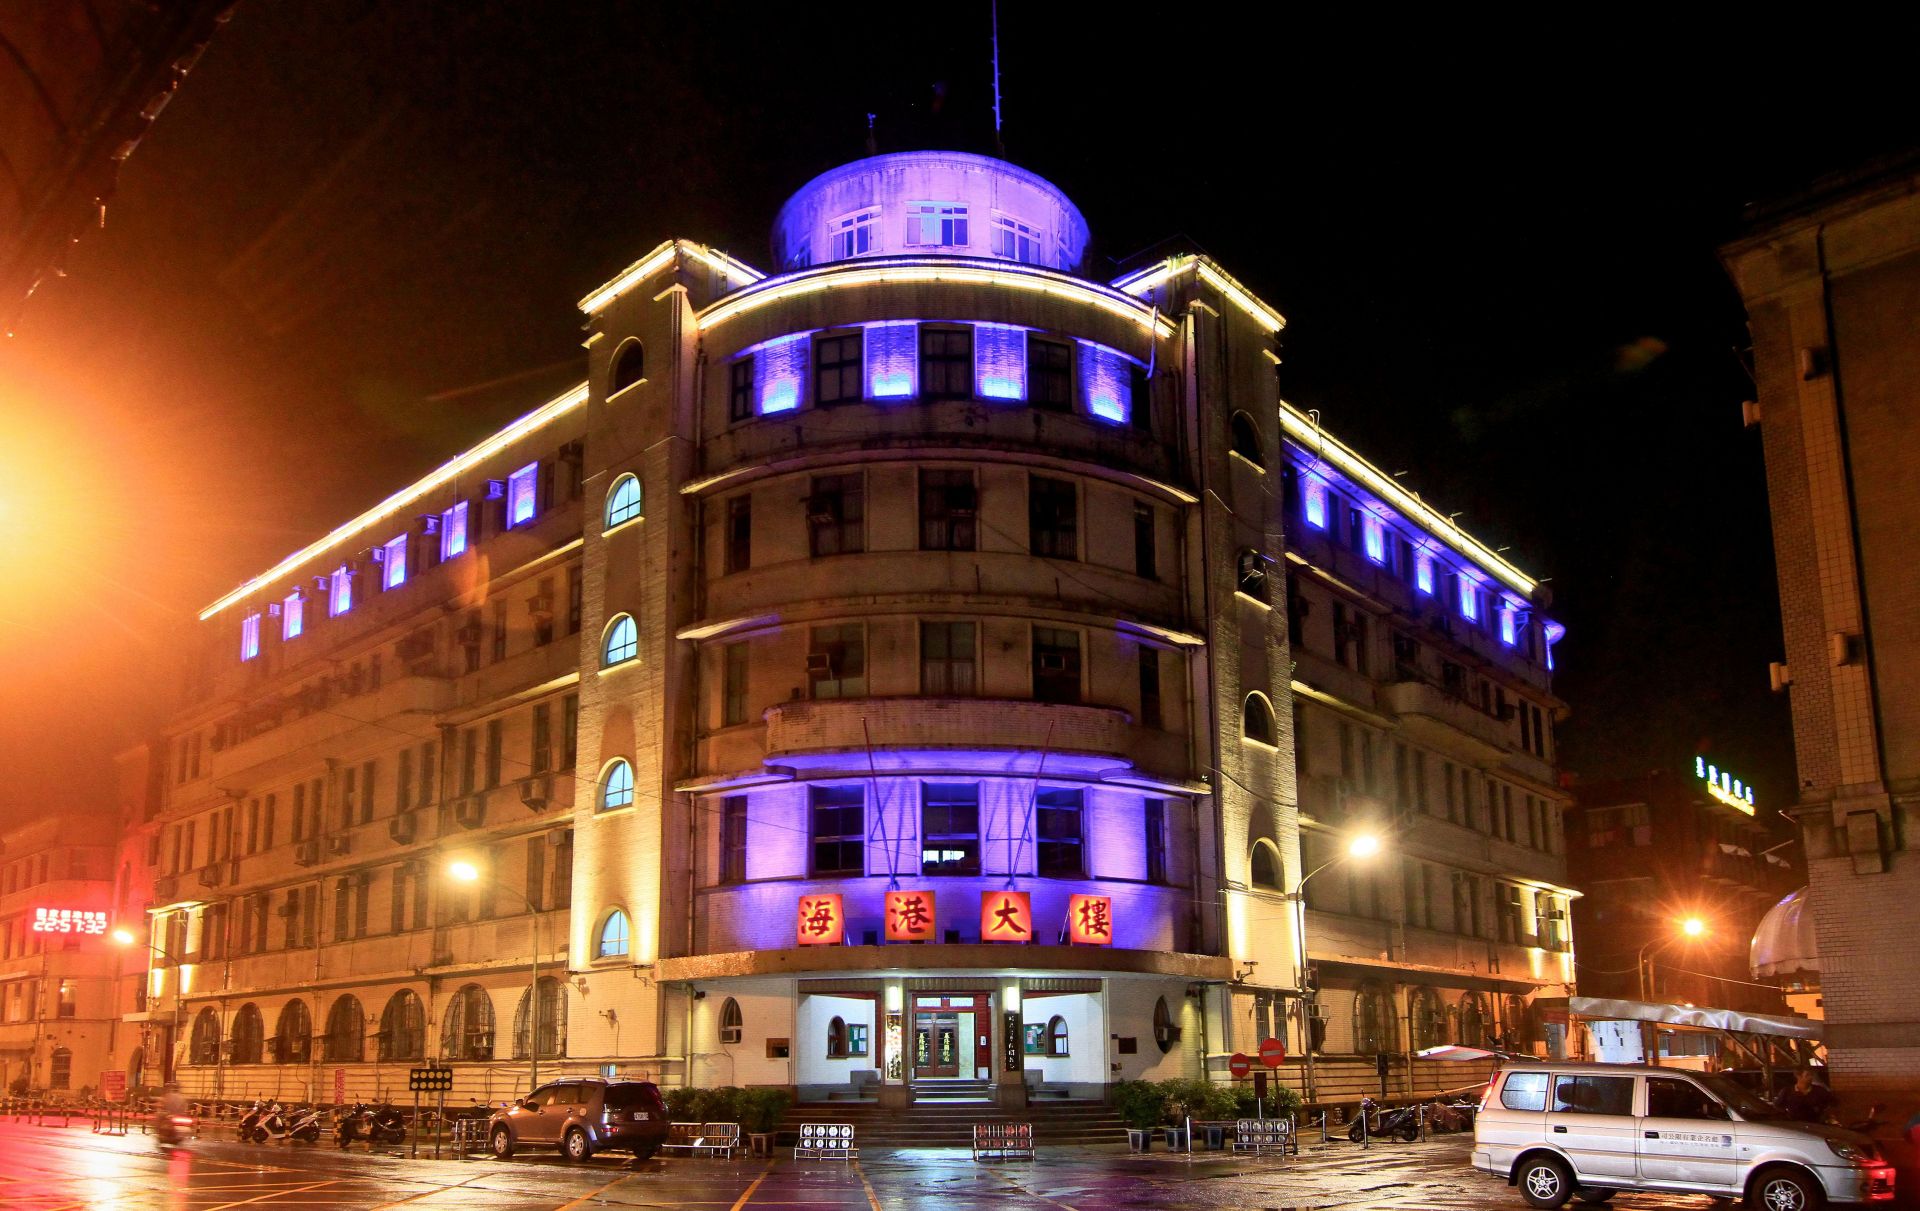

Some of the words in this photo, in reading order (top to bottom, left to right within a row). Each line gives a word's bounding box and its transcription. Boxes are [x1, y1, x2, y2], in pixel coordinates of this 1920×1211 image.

[33, 919, 107, 934] 22:57:32
[801, 896, 1110, 936] 海港大樓
